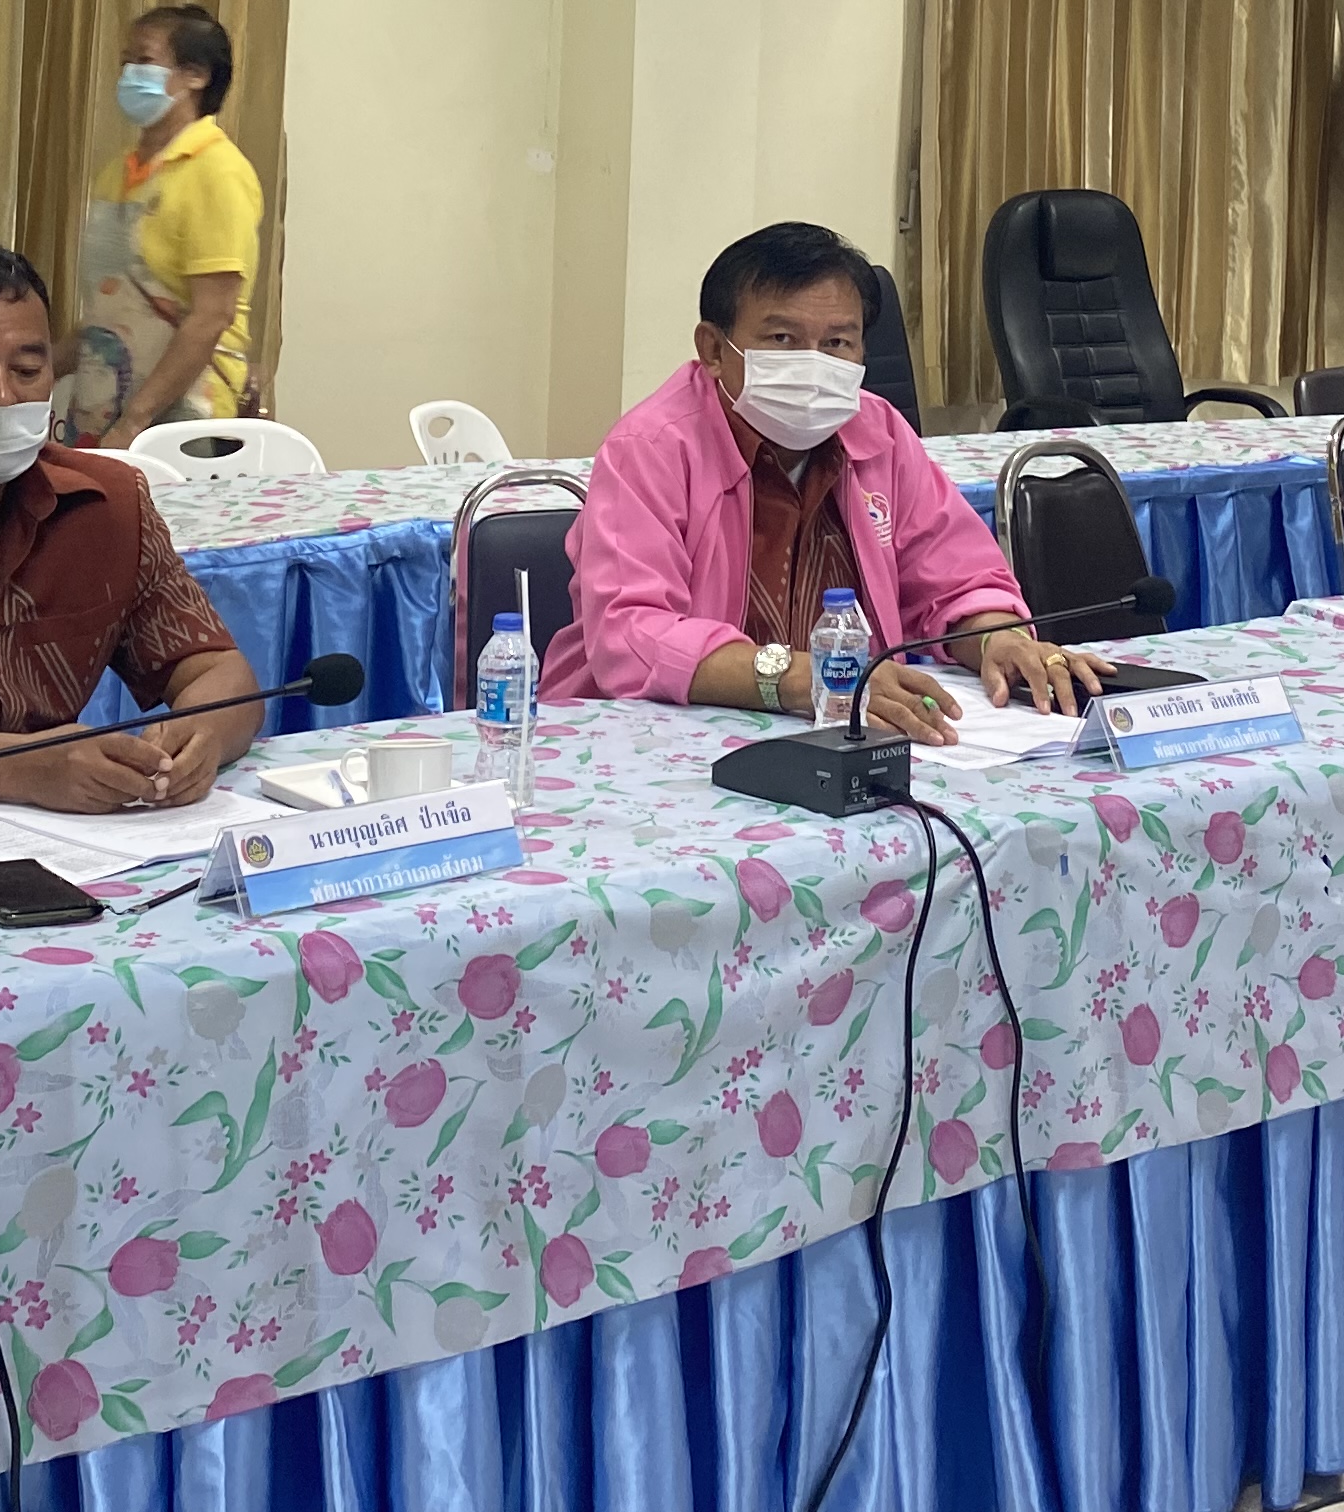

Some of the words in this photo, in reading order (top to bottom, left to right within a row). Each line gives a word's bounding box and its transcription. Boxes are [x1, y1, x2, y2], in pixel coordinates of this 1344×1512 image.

[871, 744, 909, 761] HONIC
[309, 813, 409, 849] นายบุญเลิศ
